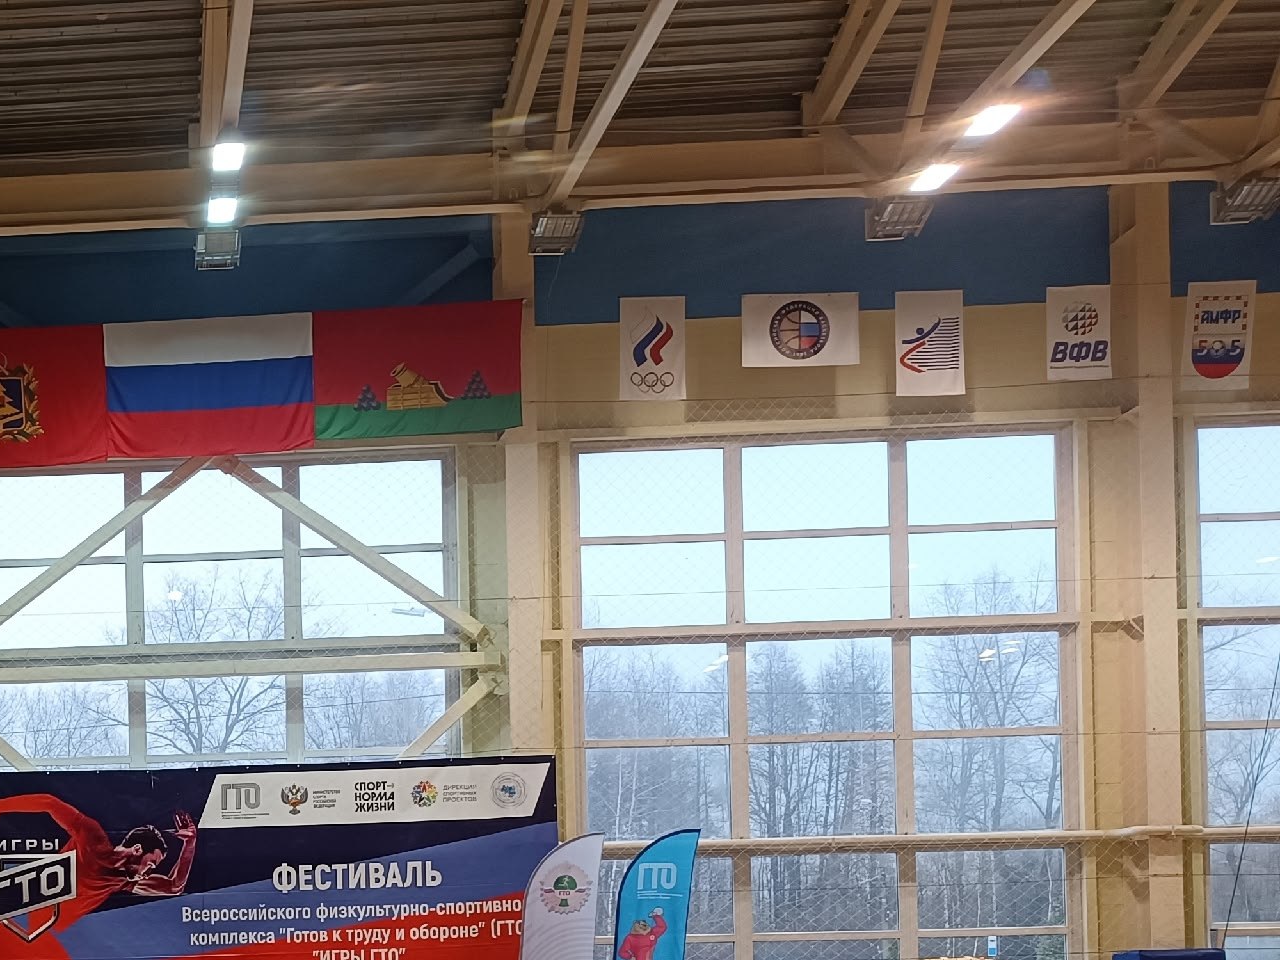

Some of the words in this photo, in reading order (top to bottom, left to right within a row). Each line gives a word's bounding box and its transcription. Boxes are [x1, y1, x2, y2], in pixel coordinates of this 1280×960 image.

[1050, 340, 1108, 362] ВФВ
[221, 783, 261, 810] ГТО
[354, 792, 395, 802] НОРМА
[354, 802, 395, 812] ЖИЗНИ
[272, 860, 442, 893] ФЕСТИВАЛЬ
[637, 863, 677, 890] ГТО
[182, 904, 311, 925] Всероссийского
[190, 931, 276, 946] комплекса
[279, 927, 328, 944] "Готов
[332, 930, 342, 942] к
[347, 928, 391, 946] труду
[396, 928, 405, 941] и
[409, 921, 485, 942] обороне"
